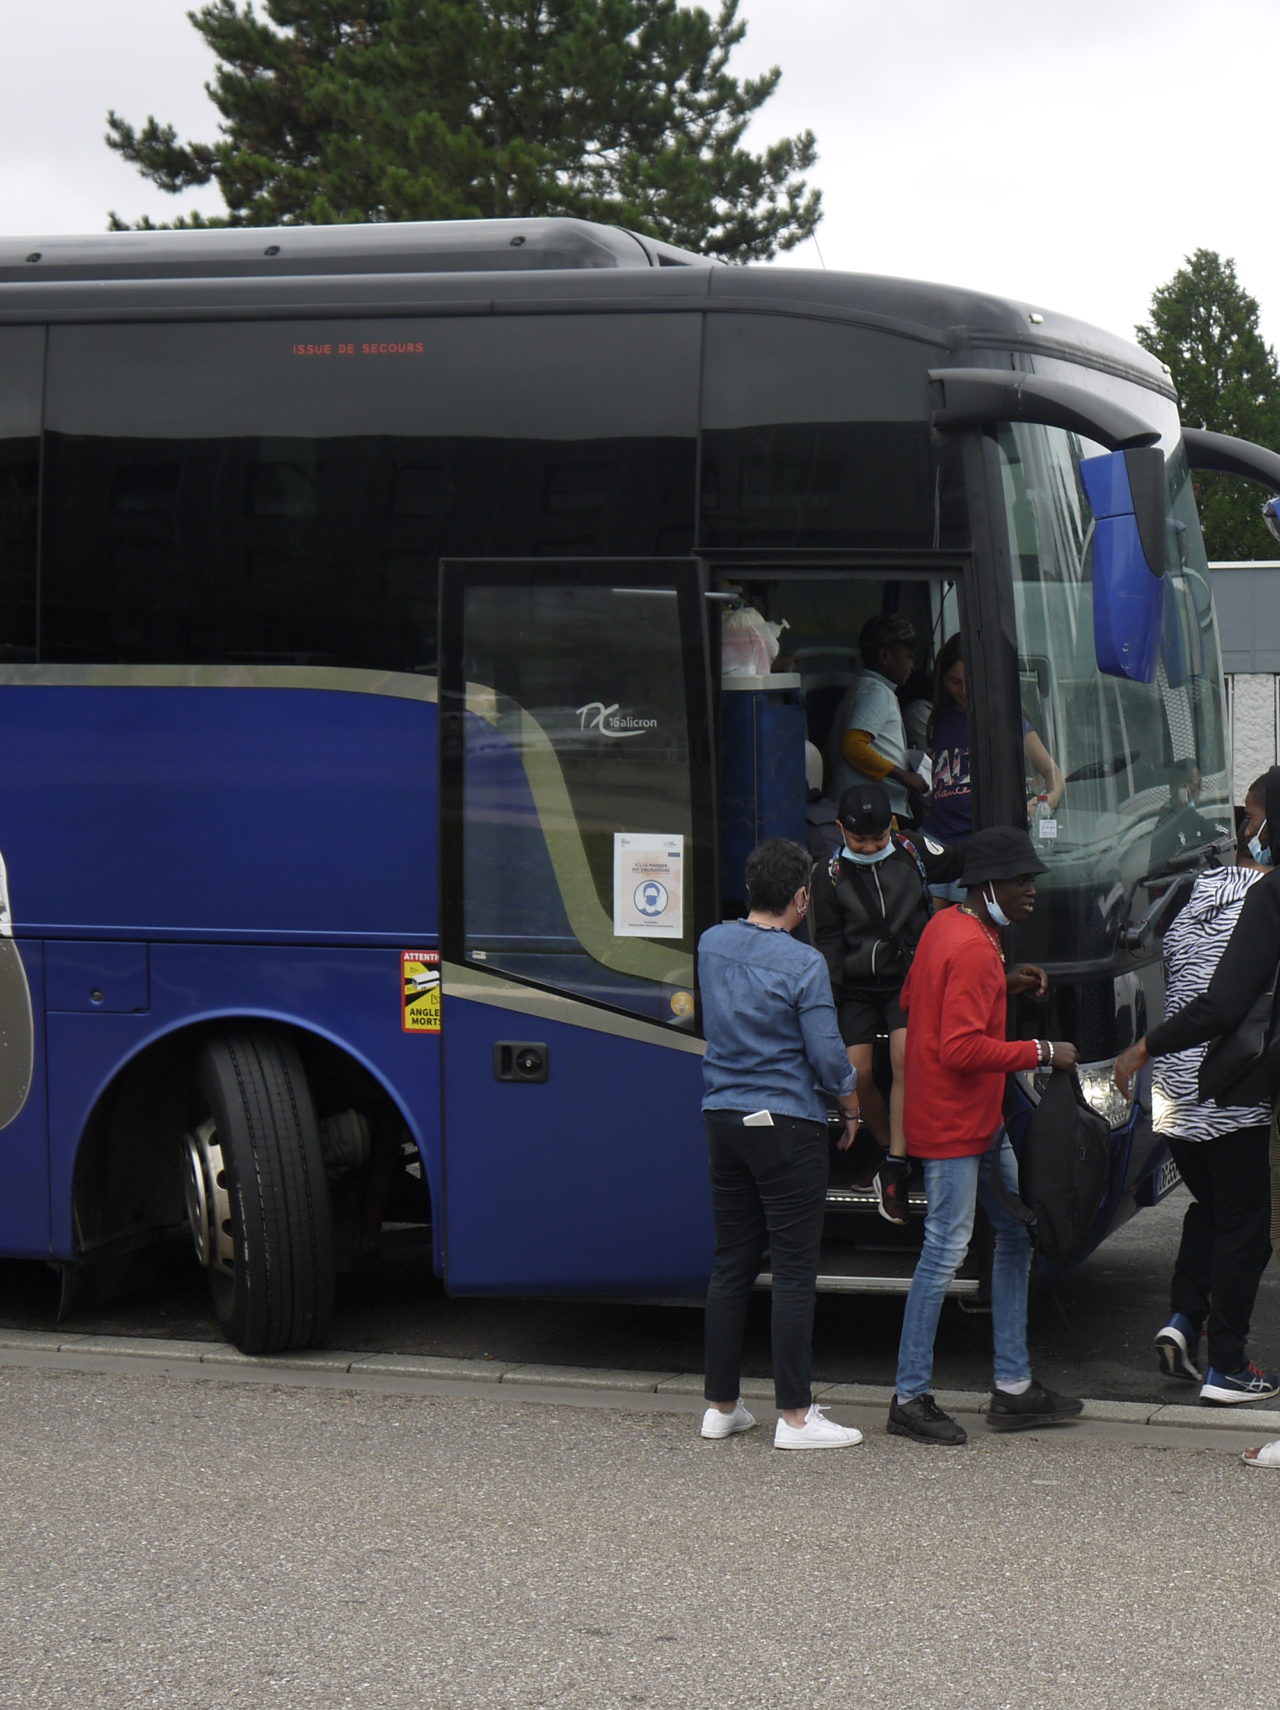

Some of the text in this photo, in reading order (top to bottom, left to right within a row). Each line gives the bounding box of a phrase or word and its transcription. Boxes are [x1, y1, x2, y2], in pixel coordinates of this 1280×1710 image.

[292, 342, 425, 355] ISSUE DE SECOURS
[404, 953, 440, 961] ATTENTI
[409, 1008, 440, 1017] ANGLE
